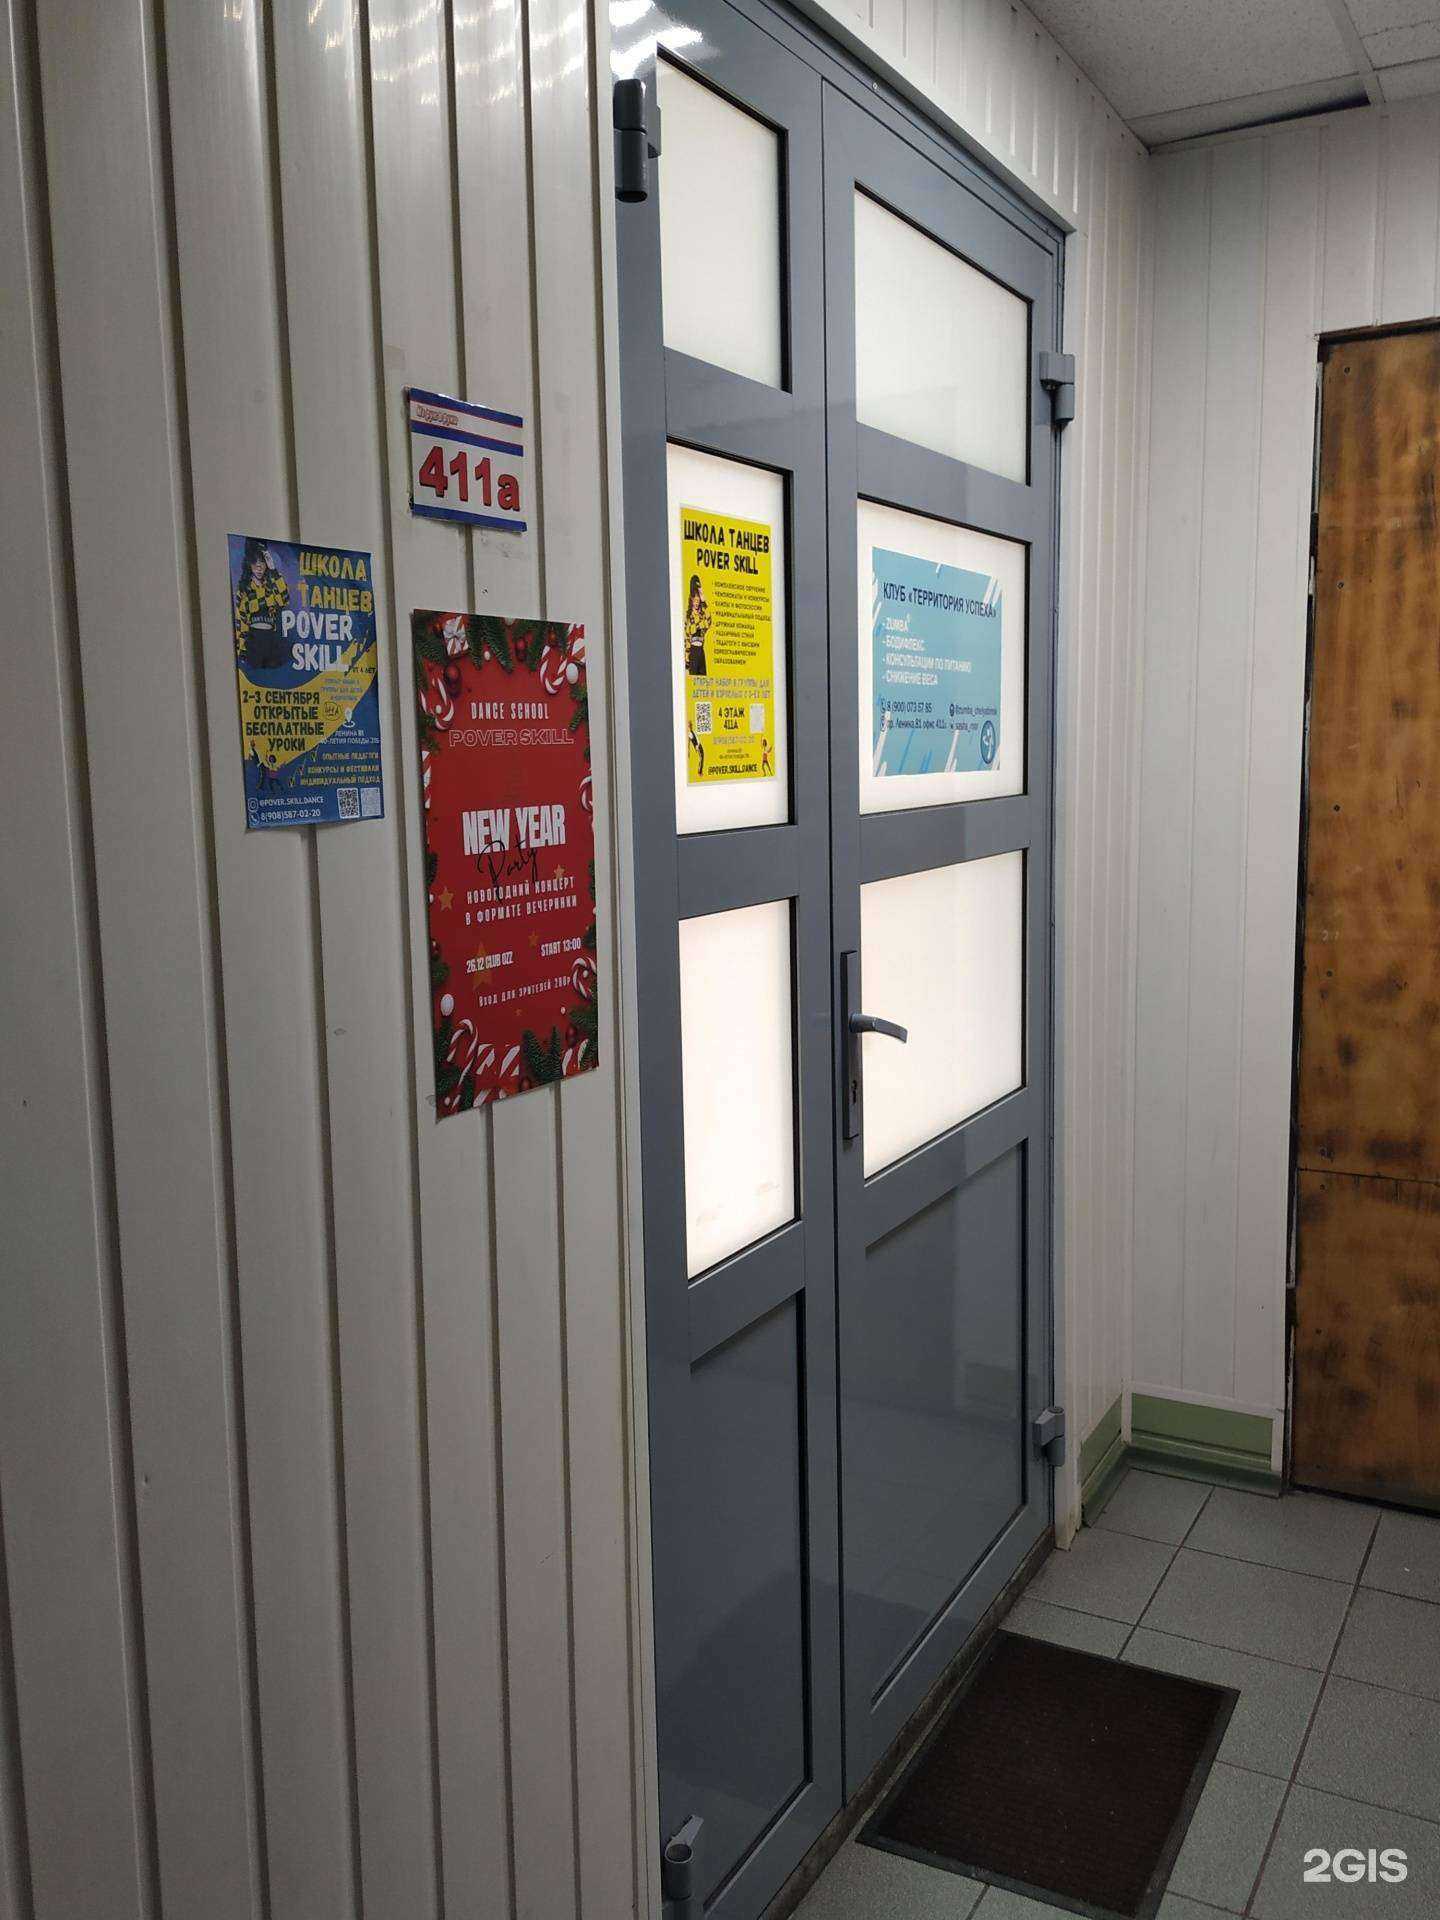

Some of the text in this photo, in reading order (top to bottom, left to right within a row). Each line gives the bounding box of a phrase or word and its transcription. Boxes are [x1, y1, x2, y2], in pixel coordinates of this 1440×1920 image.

[683, 520, 769, 556] ШКОЛА ТАНЦЕВ
[299, 552, 367, 581] ШКОЛА
[697, 549, 758, 575] POVER SKILL
[298, 581, 373, 614] ТАНЦЕВ
[883, 582, 906, 601] КЛУБ
[281, 610, 353, 641] POVER
[292, 643, 351, 672] SKILL
[265, 692, 320, 704] СЕНТЯБРЯ
[254, 706, 319, 720] ОТКРЫТЫЕ
[471, 702, 549, 719] DANCE SCHOOL
[724, 707, 745, 718] ЭТАЖ
[246, 722, 324, 736] БЕСПЛАТНЫЕ
[267, 738, 306, 752] УРОКИ
[462, 804, 567, 856] NEW YEAR
[467, 876, 575, 905] НОВОГОДНИЙ КОНЦЕРТ
[465, 895, 578, 926] В ФОРМАТЕ ВЕЧЕРИНКИ
[541, 937, 582, 957] START 13:00
[466, 958, 485, 974] 26.12
[485, 954, 501, 969] CLUB
